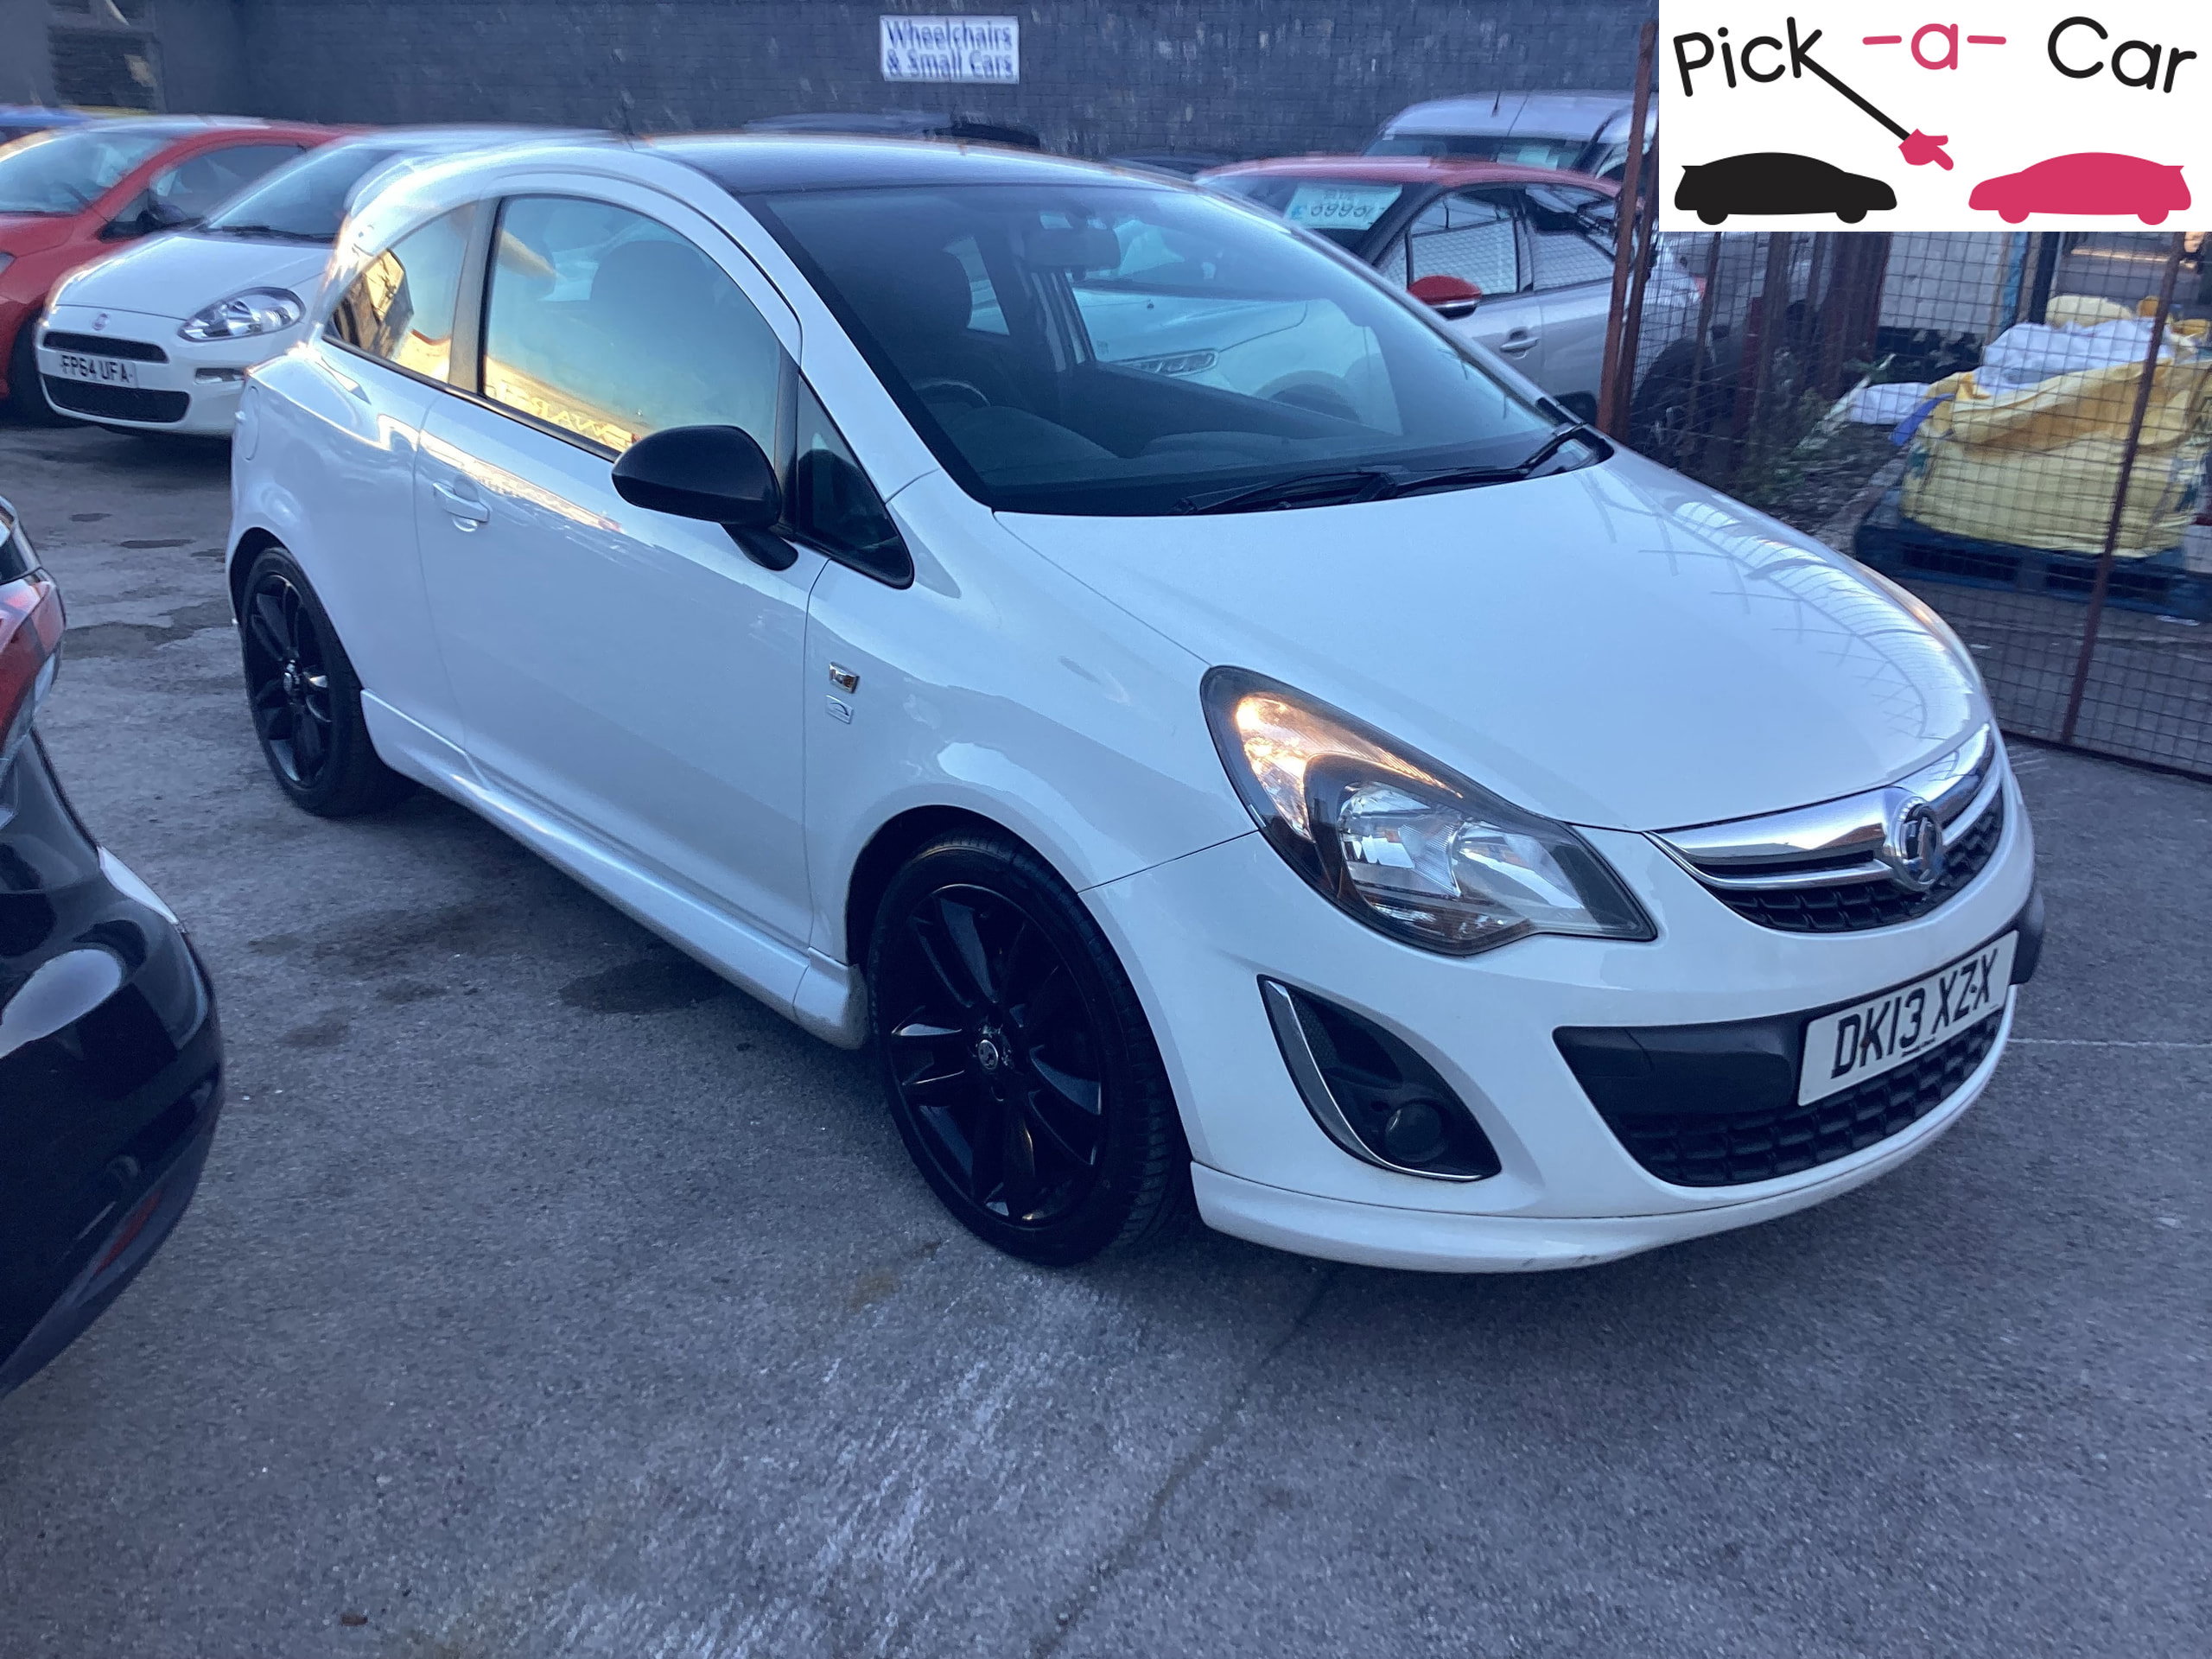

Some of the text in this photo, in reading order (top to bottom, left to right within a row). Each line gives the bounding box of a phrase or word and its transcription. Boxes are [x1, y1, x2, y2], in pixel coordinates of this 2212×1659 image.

[882, 18, 1013, 49] Wheelchairs
[886, 48, 1013, 79] & Small Cars
[100, 360, 130, 383] UFA
[1830, 948, 1999, 1079] DK13 XZX
